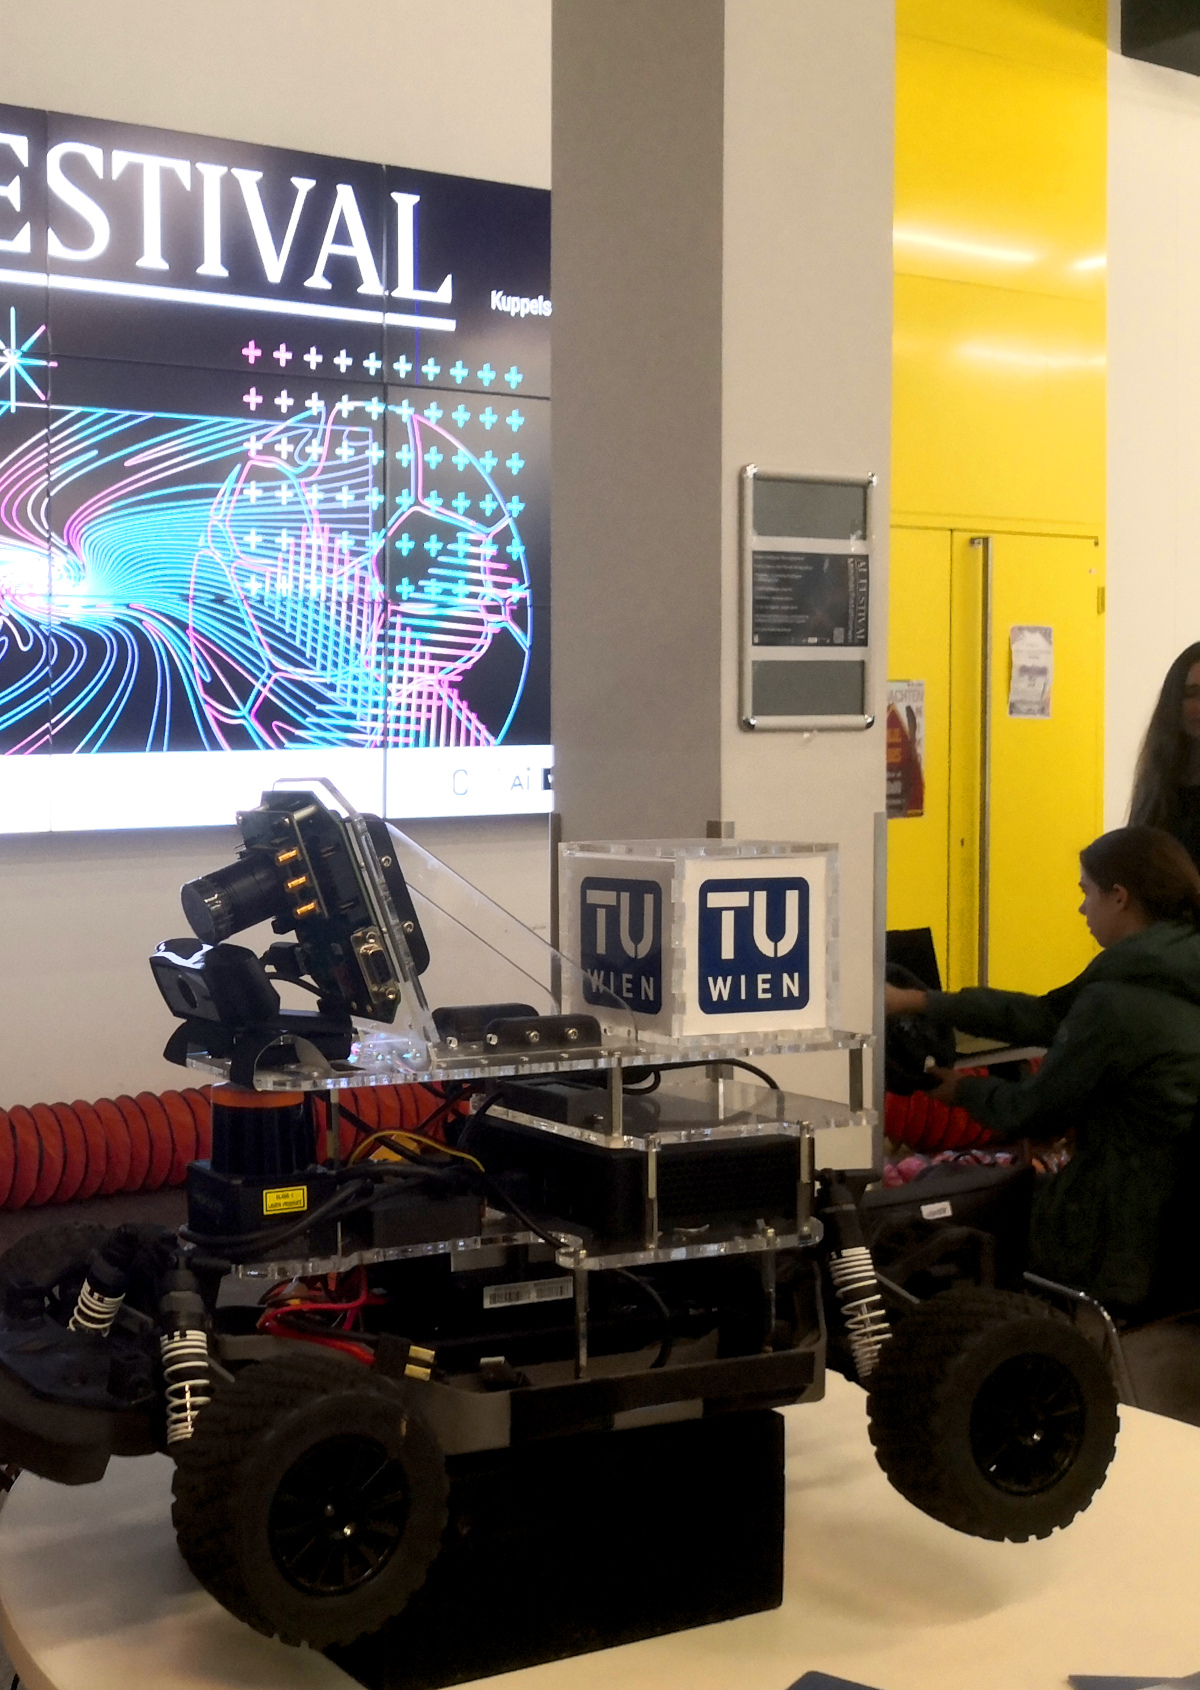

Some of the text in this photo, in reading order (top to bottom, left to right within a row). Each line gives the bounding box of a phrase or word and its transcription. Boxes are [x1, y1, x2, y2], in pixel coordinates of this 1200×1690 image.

[490, 289, 553, 318] Kuppels
[586, 889, 654, 959] TU
[706, 889, 799, 960] TU
[587, 968, 654, 1001] WIEN
[707, 972, 800, 1001] WIEN
